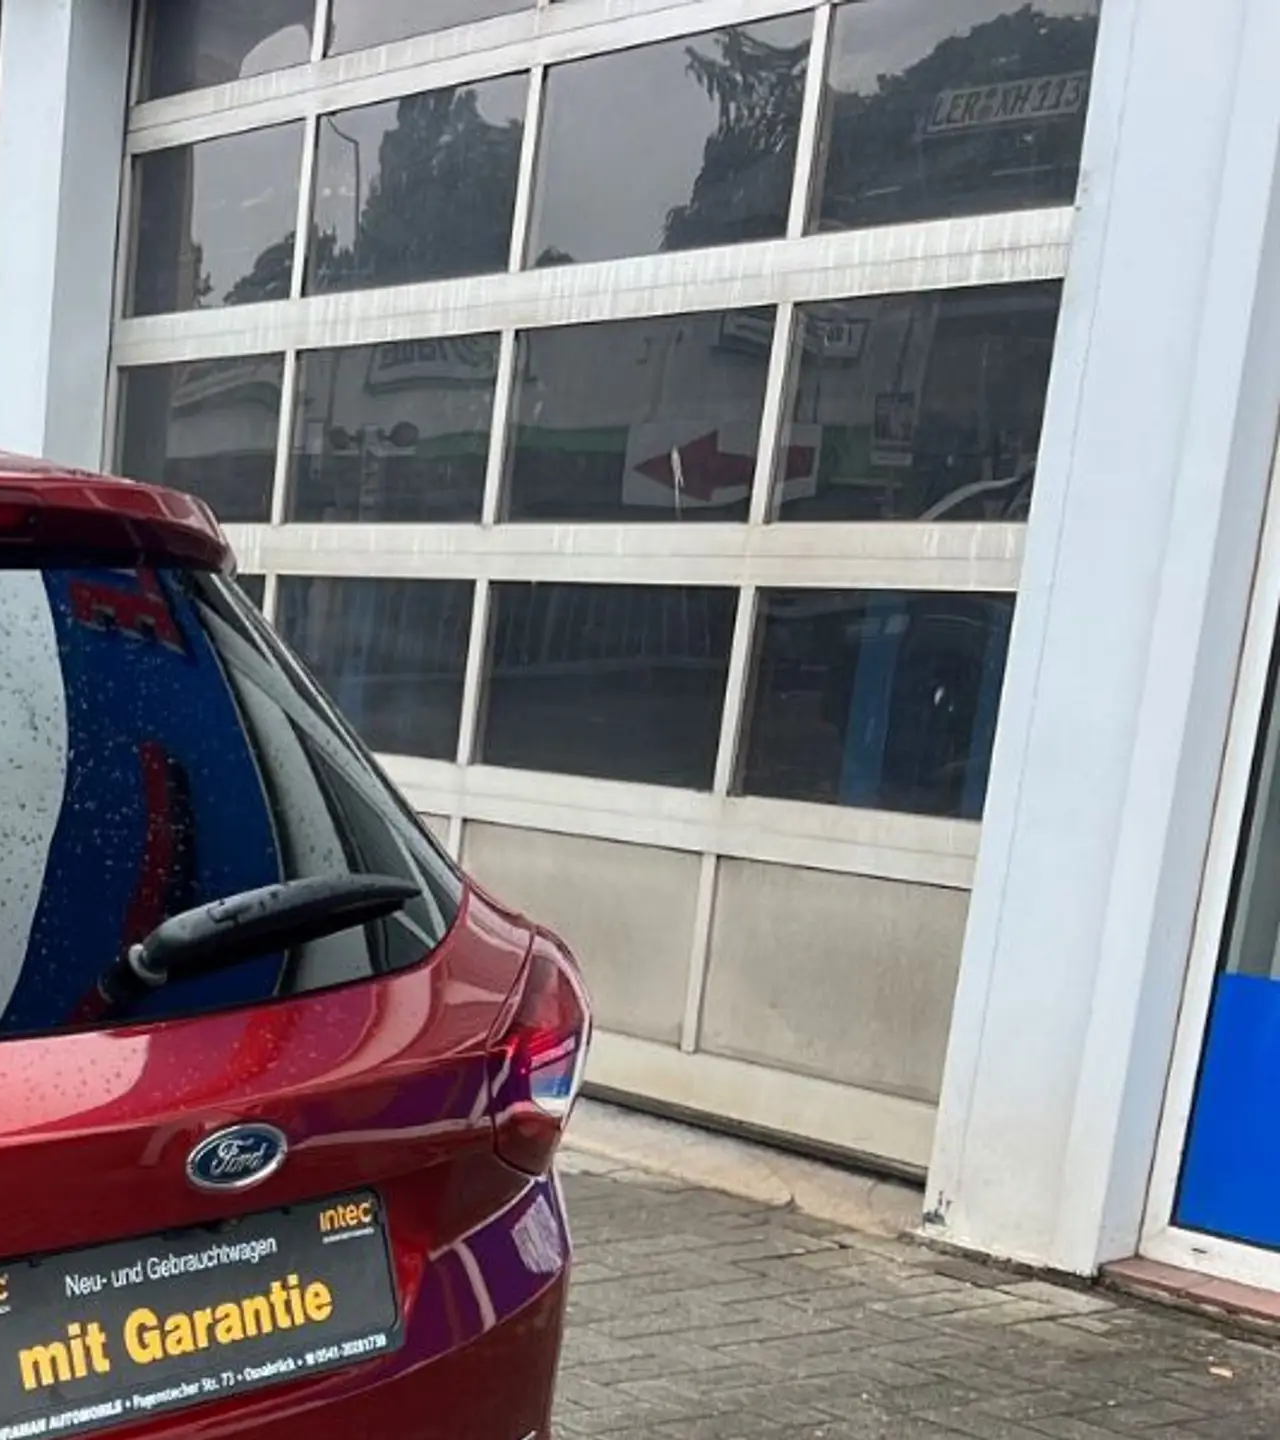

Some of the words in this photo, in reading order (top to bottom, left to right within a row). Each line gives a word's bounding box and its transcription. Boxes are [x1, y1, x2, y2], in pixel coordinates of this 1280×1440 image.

[210, 1137, 269, 1176] Ford
[320, 1201, 372, 1232] intec
[64, 1273, 107, 1298] Neu-
[111, 1261, 142, 1288] und
[146, 1236, 278, 1280] Gebrauchtwagen
[17, 1320, 111, 1391] mit
[124, 1272, 333, 1365] Garantie
